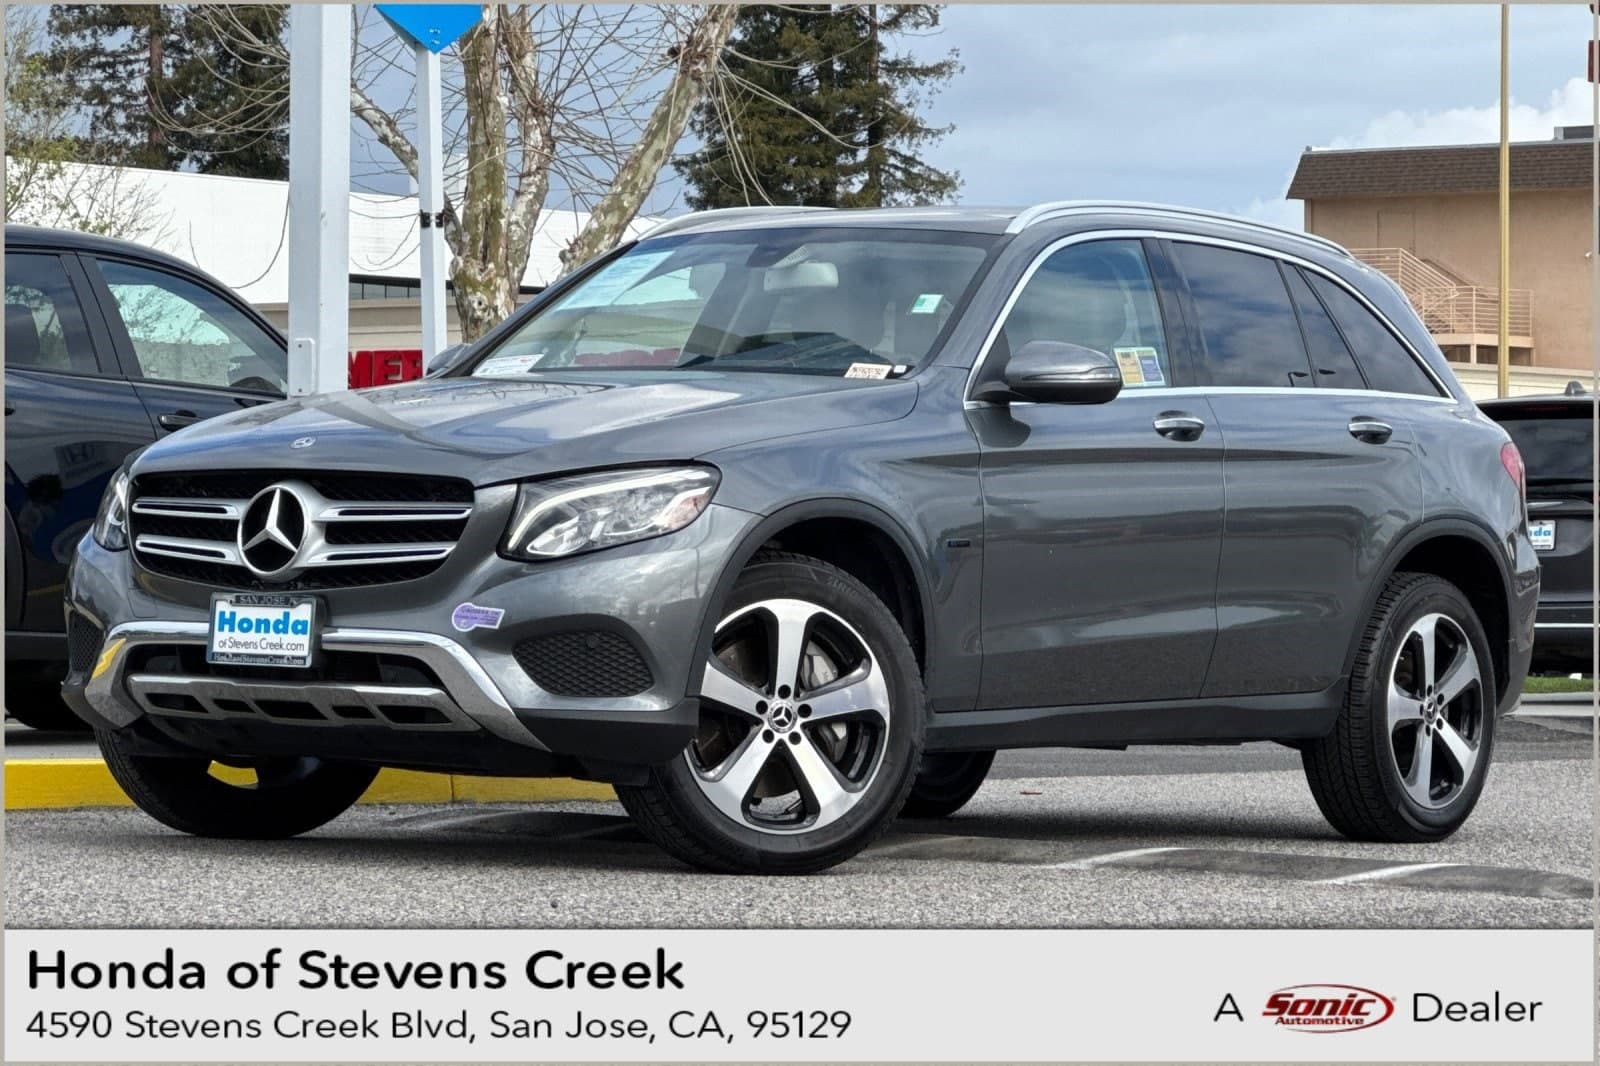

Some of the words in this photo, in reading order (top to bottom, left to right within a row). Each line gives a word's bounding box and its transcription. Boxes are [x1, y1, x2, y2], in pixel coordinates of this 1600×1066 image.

[240, 595, 258, 604] SAN
[218, 611, 308, 635] Honda
[218, 637, 229, 649] of
[228, 636, 259, 650] Stevens
[260, 637, 305, 652] Creek.com
